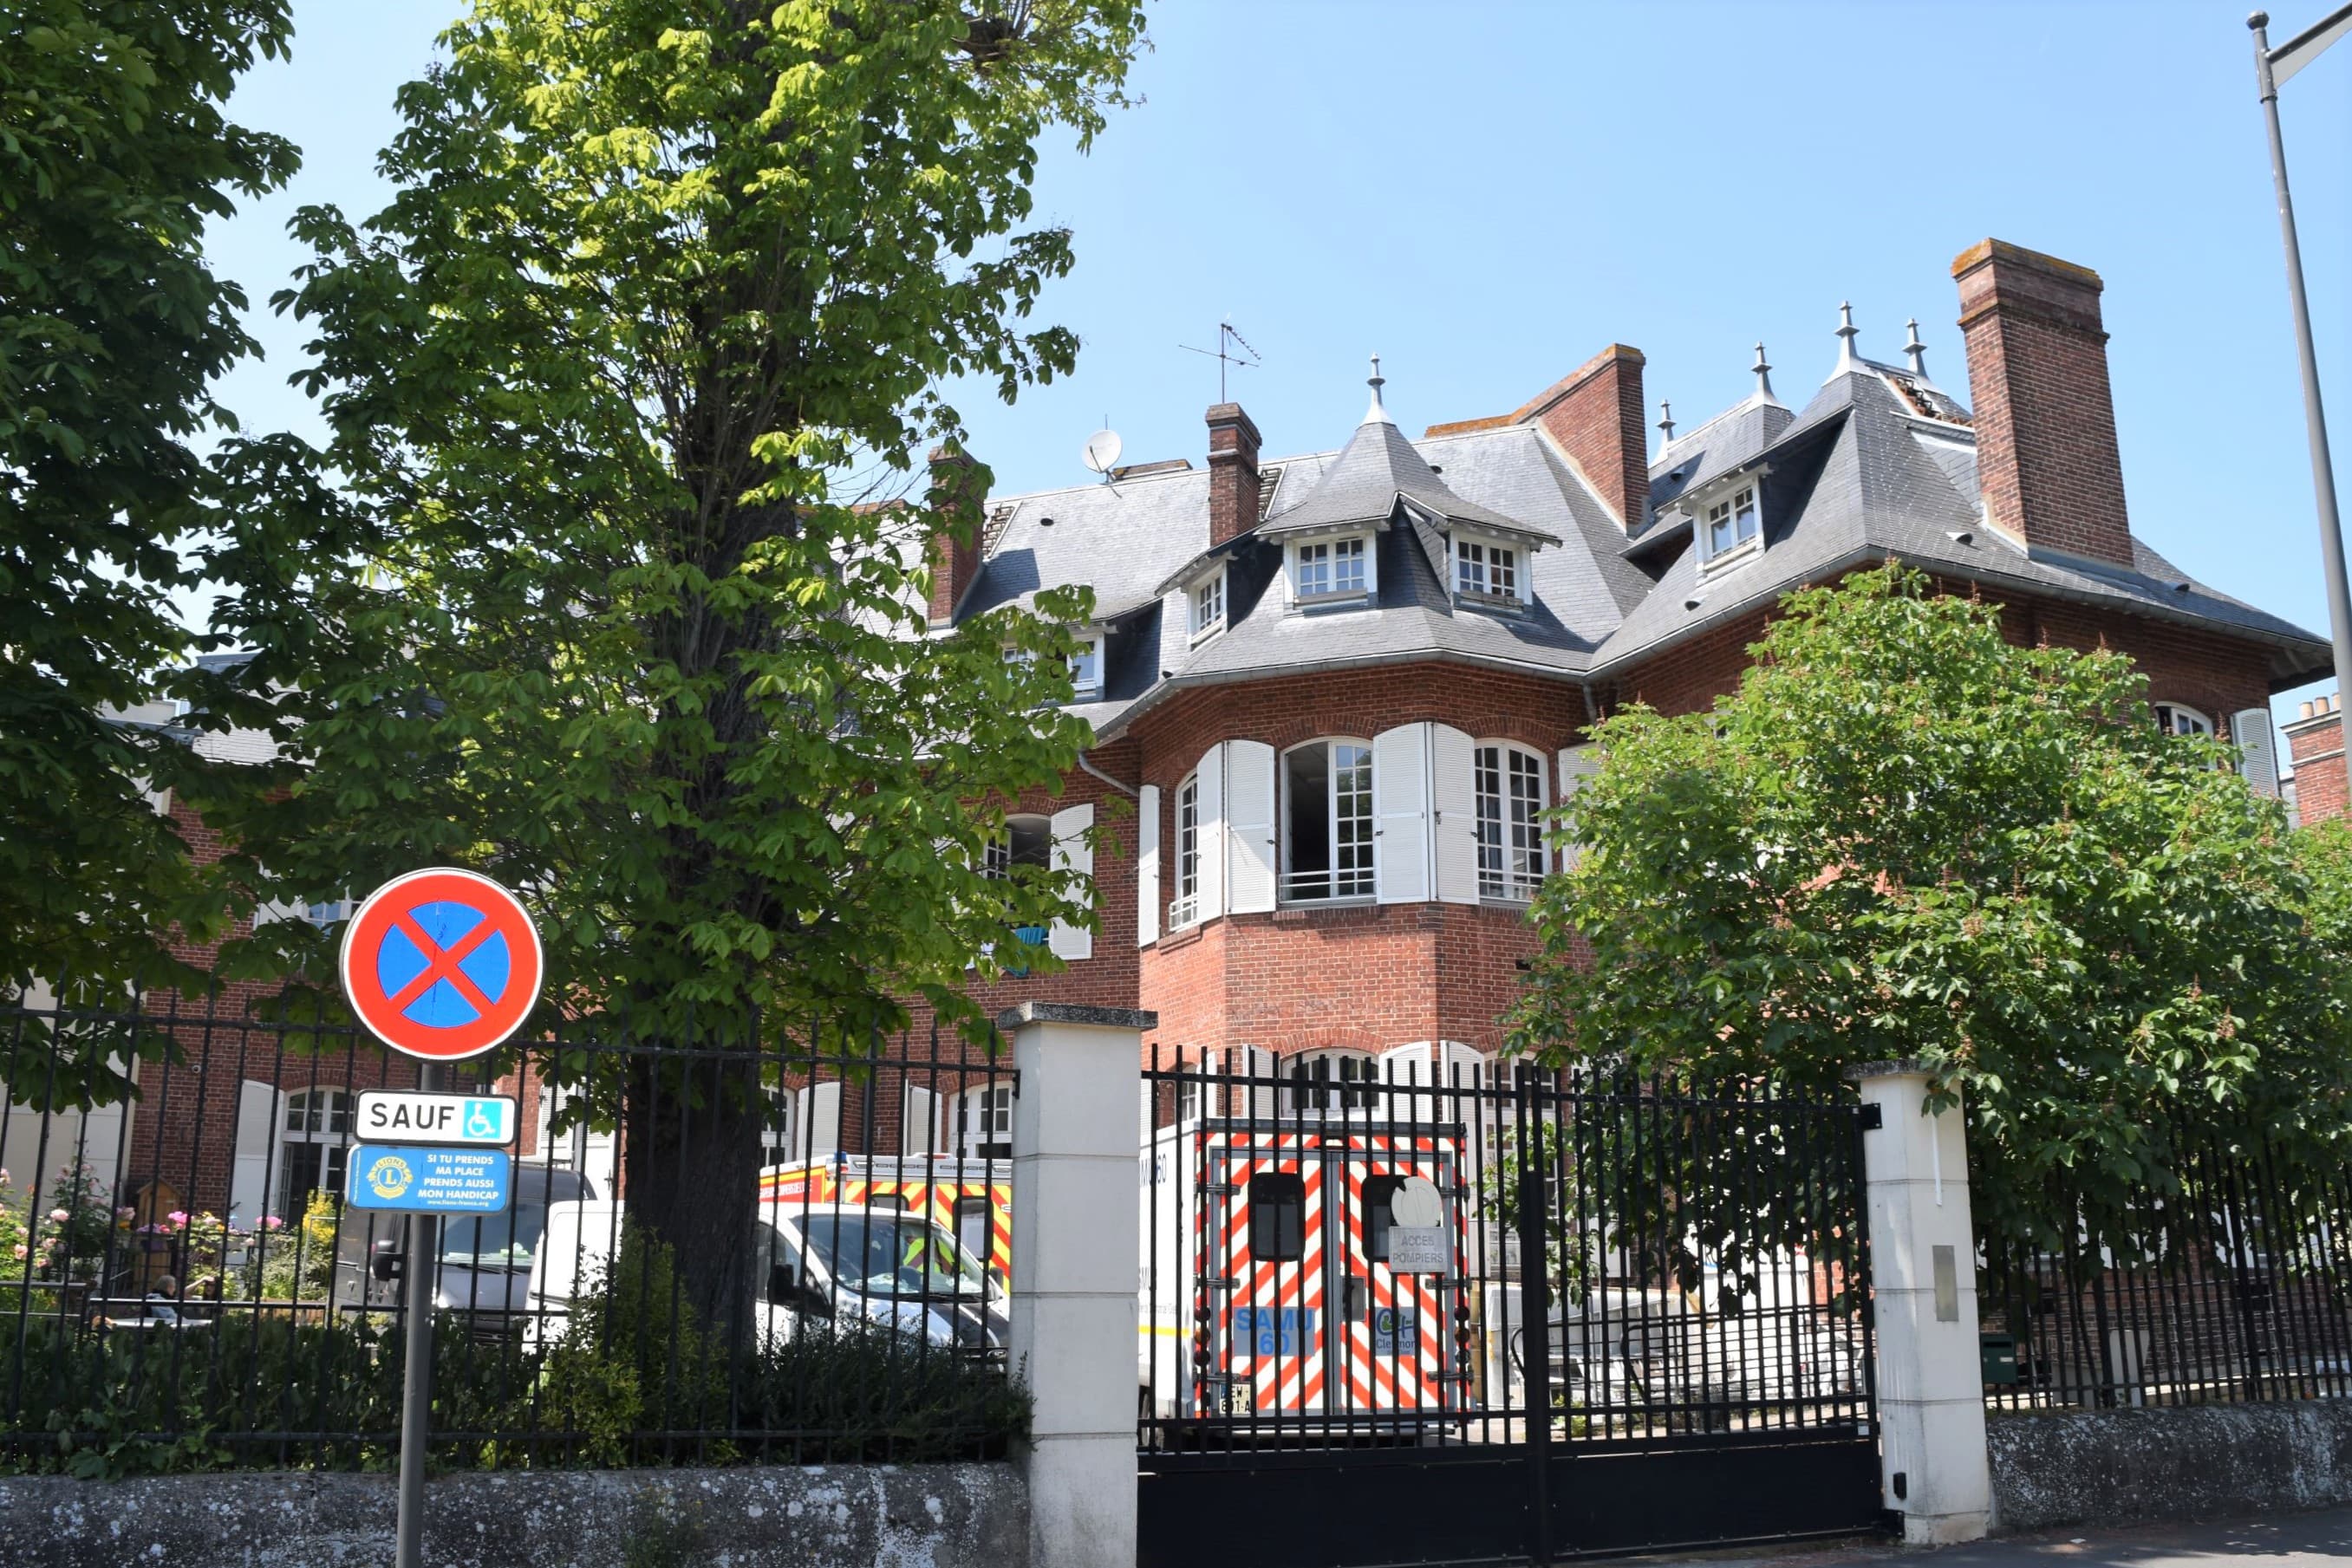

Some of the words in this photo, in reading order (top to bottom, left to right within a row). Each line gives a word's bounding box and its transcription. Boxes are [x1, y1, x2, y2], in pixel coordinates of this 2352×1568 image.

[370, 1102, 455, 1130] SAUF
[377, 1157, 404, 1168] LIONS
[427, 1154, 437, 1163] SI
[440, 1155, 453, 1163] TU
[454, 1155, 494, 1165] PRENDS
[385, 1168, 398, 1185] L
[435, 1166, 452, 1175] MA
[454, 1167, 485, 1176] PLACE
[424, 1177, 463, 1187] PRENDS
[465, 1179, 495, 1188] AUSSI
[418, 1188, 444, 1199] MON
[446, 1190, 499, 1200] HANDICAP
[1393, 1252, 1444, 1263] POMPIERS
